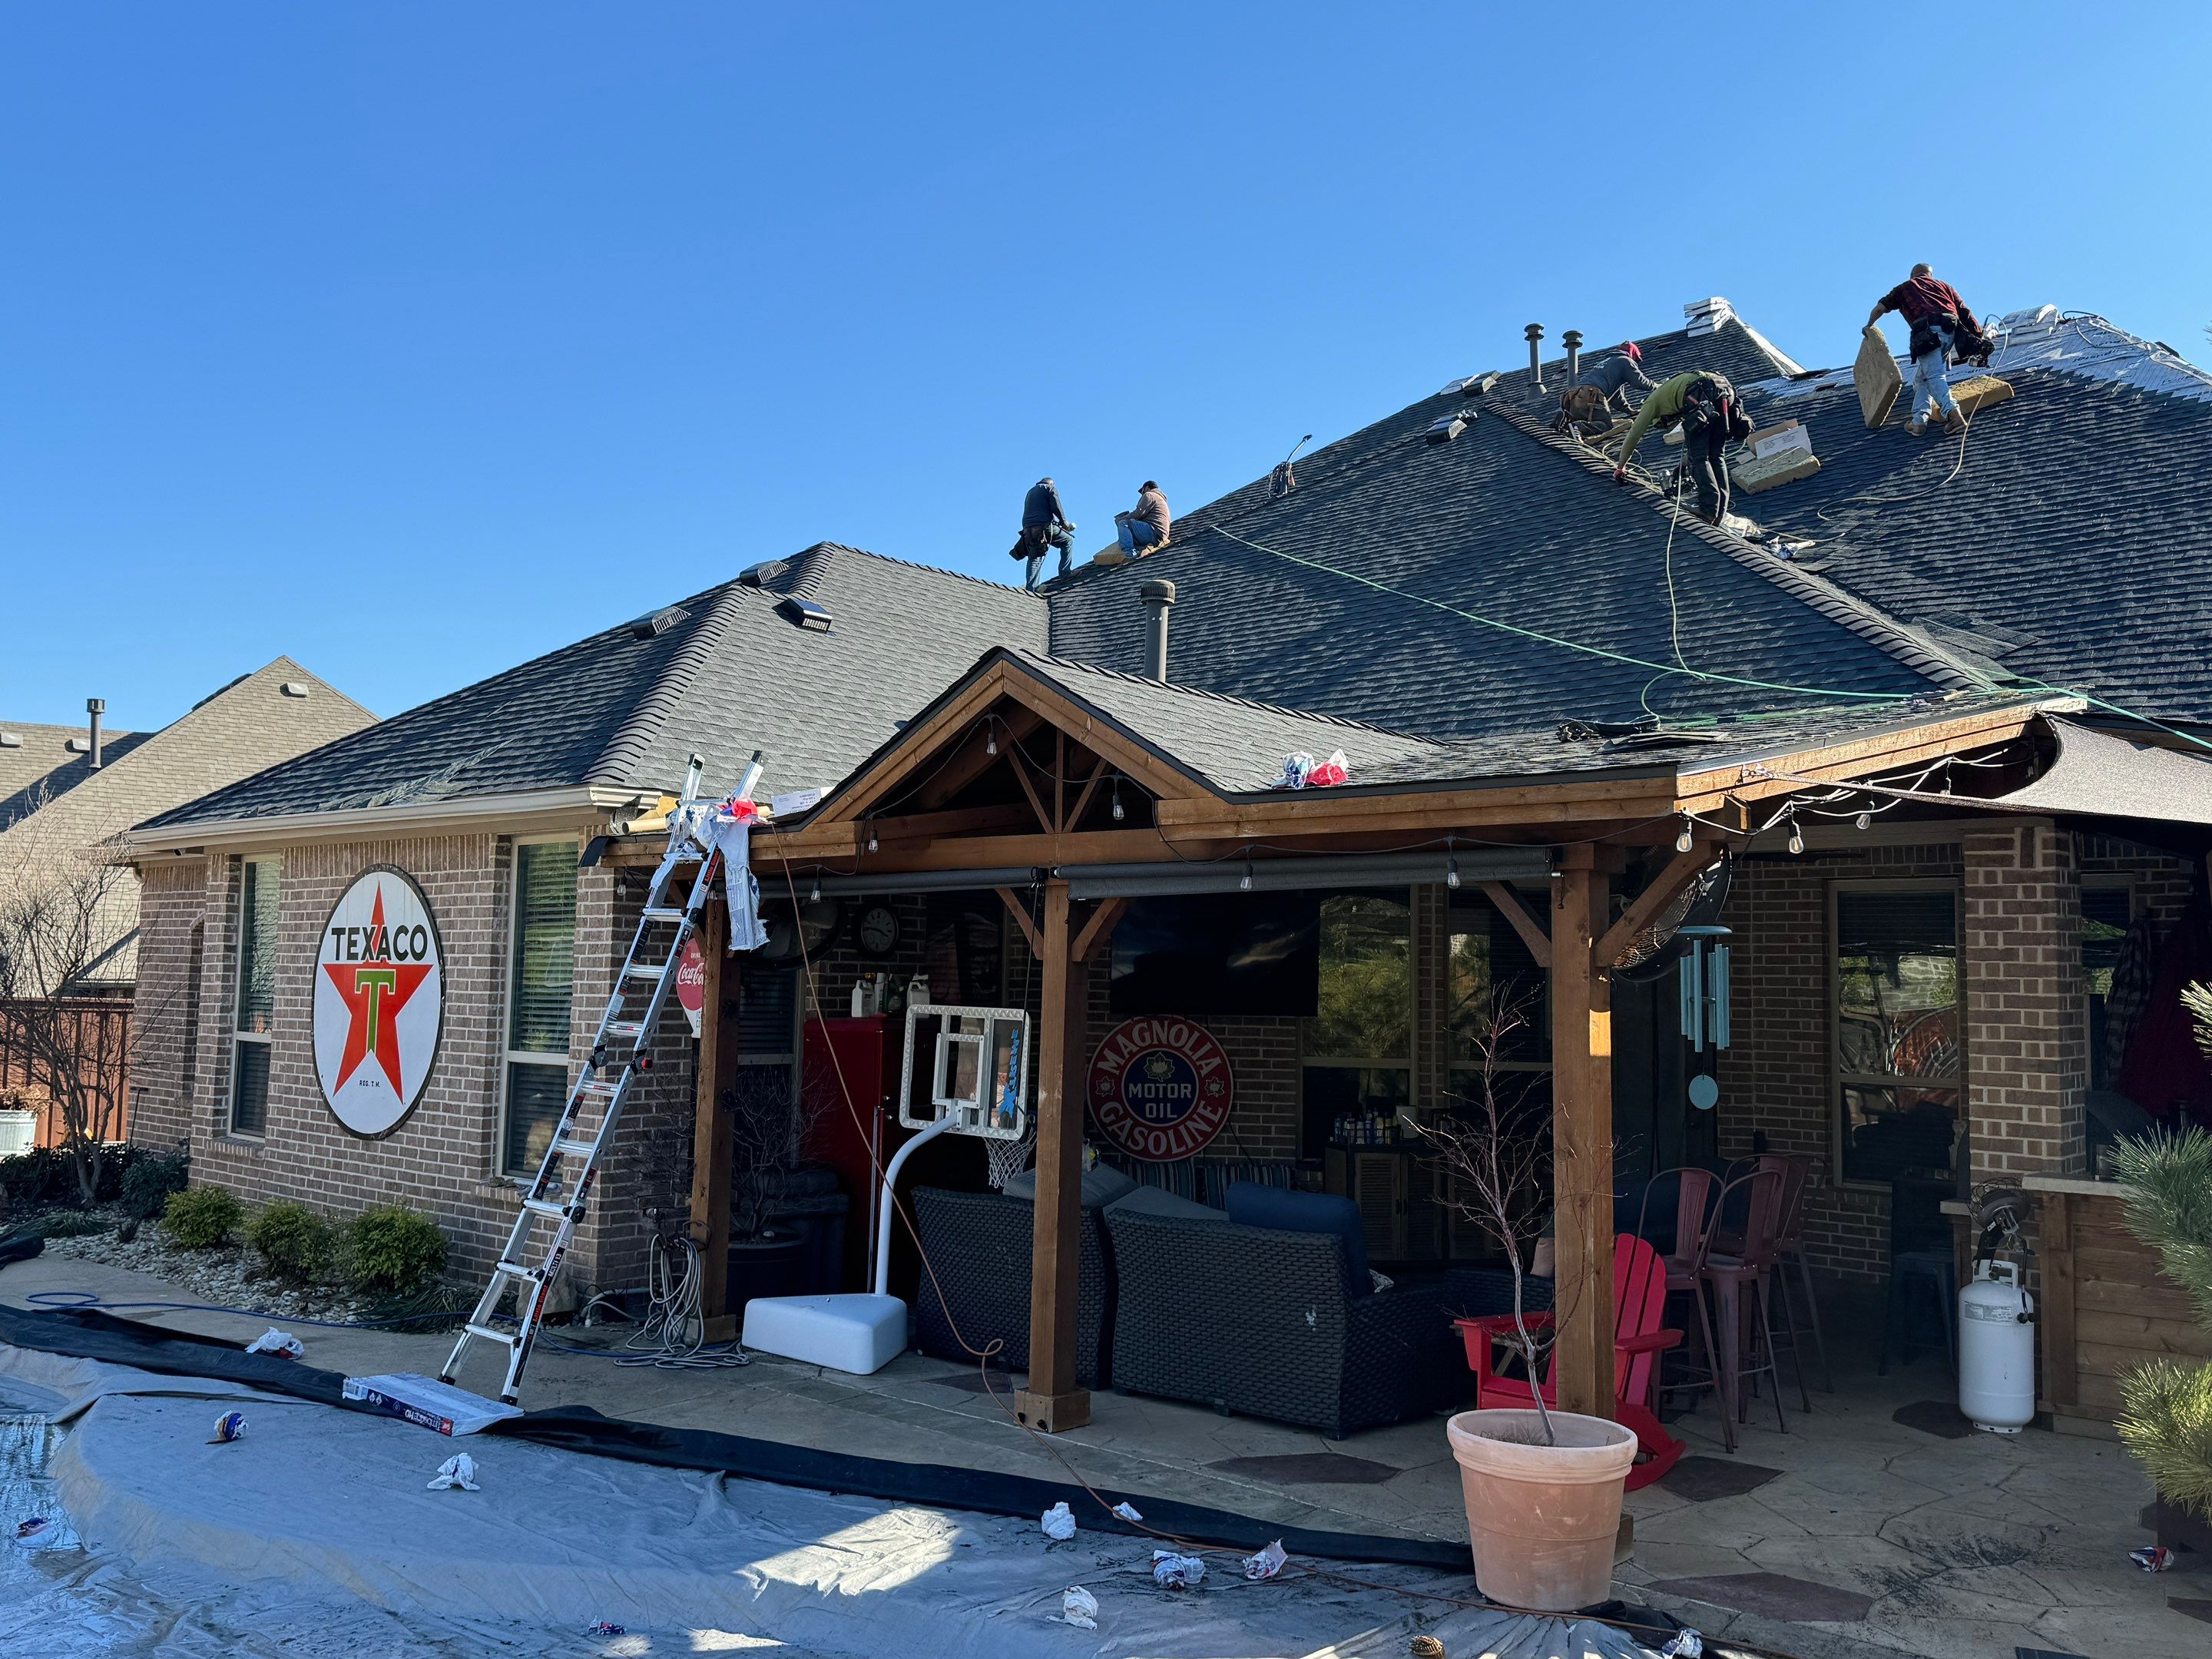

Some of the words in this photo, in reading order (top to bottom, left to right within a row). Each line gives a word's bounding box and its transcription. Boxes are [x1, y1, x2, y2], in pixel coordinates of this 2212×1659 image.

[331, 924, 428, 961] TEXACO
[677, 962, 704, 985] Coca-Co
[1097, 1020, 1222, 1076] MAGNOLIA
[1129, 1083, 1191, 1098] MOTOR
[1145, 1103, 1177, 1118] OIL
[1100, 1101, 1223, 1155] GASOLINE
